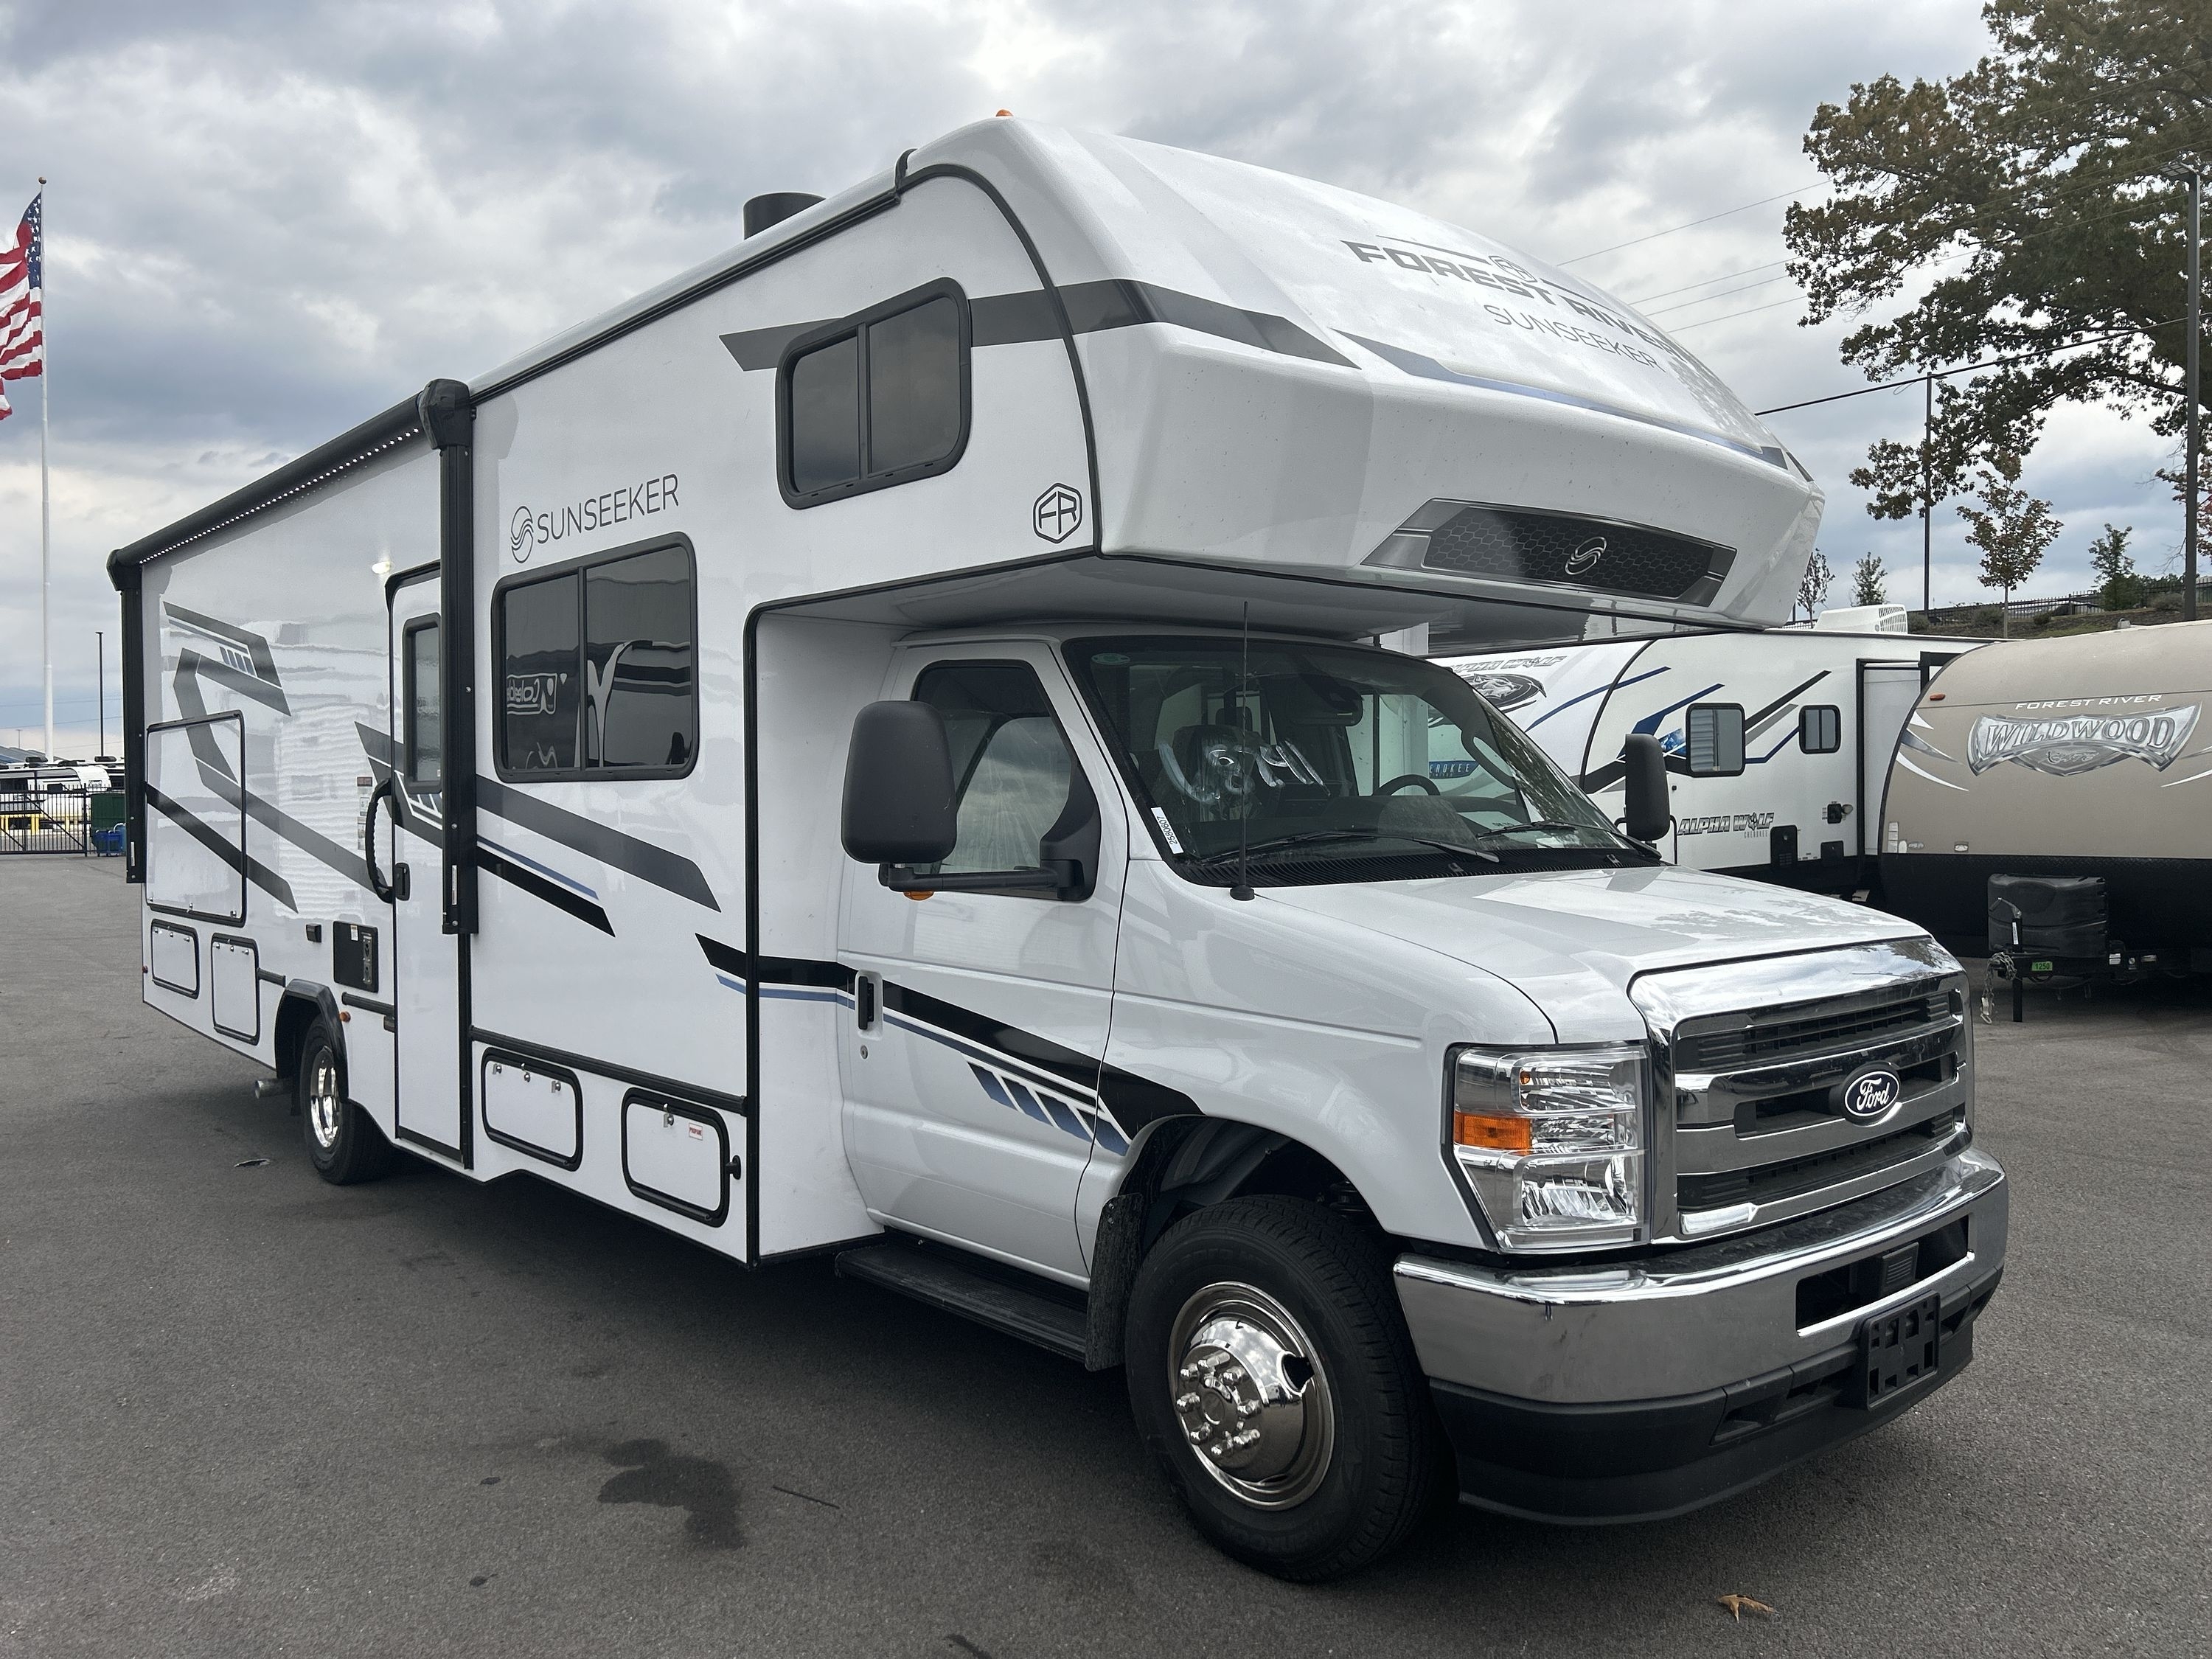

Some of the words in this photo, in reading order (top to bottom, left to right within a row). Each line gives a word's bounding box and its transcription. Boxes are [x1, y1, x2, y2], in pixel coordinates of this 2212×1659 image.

[1340, 240, 1557, 305] FOREST
[1557, 294, 1687, 363] RIVER
[1484, 305, 1666, 372] SUNSEEKER
[538, 473, 679, 544] SUNSEEKER
[2015, 699, 2095, 710] FOREST
[2098, 695, 2162, 705] RIVER
[1986, 717, 2175, 755] WILDWOOD
[1430, 763, 1470, 773] EROKEE
[1156, 816, 1178, 845] 2580607
[1677, 815, 1730, 835] ALPHA
[1857, 1078, 1890, 1110] Ford
